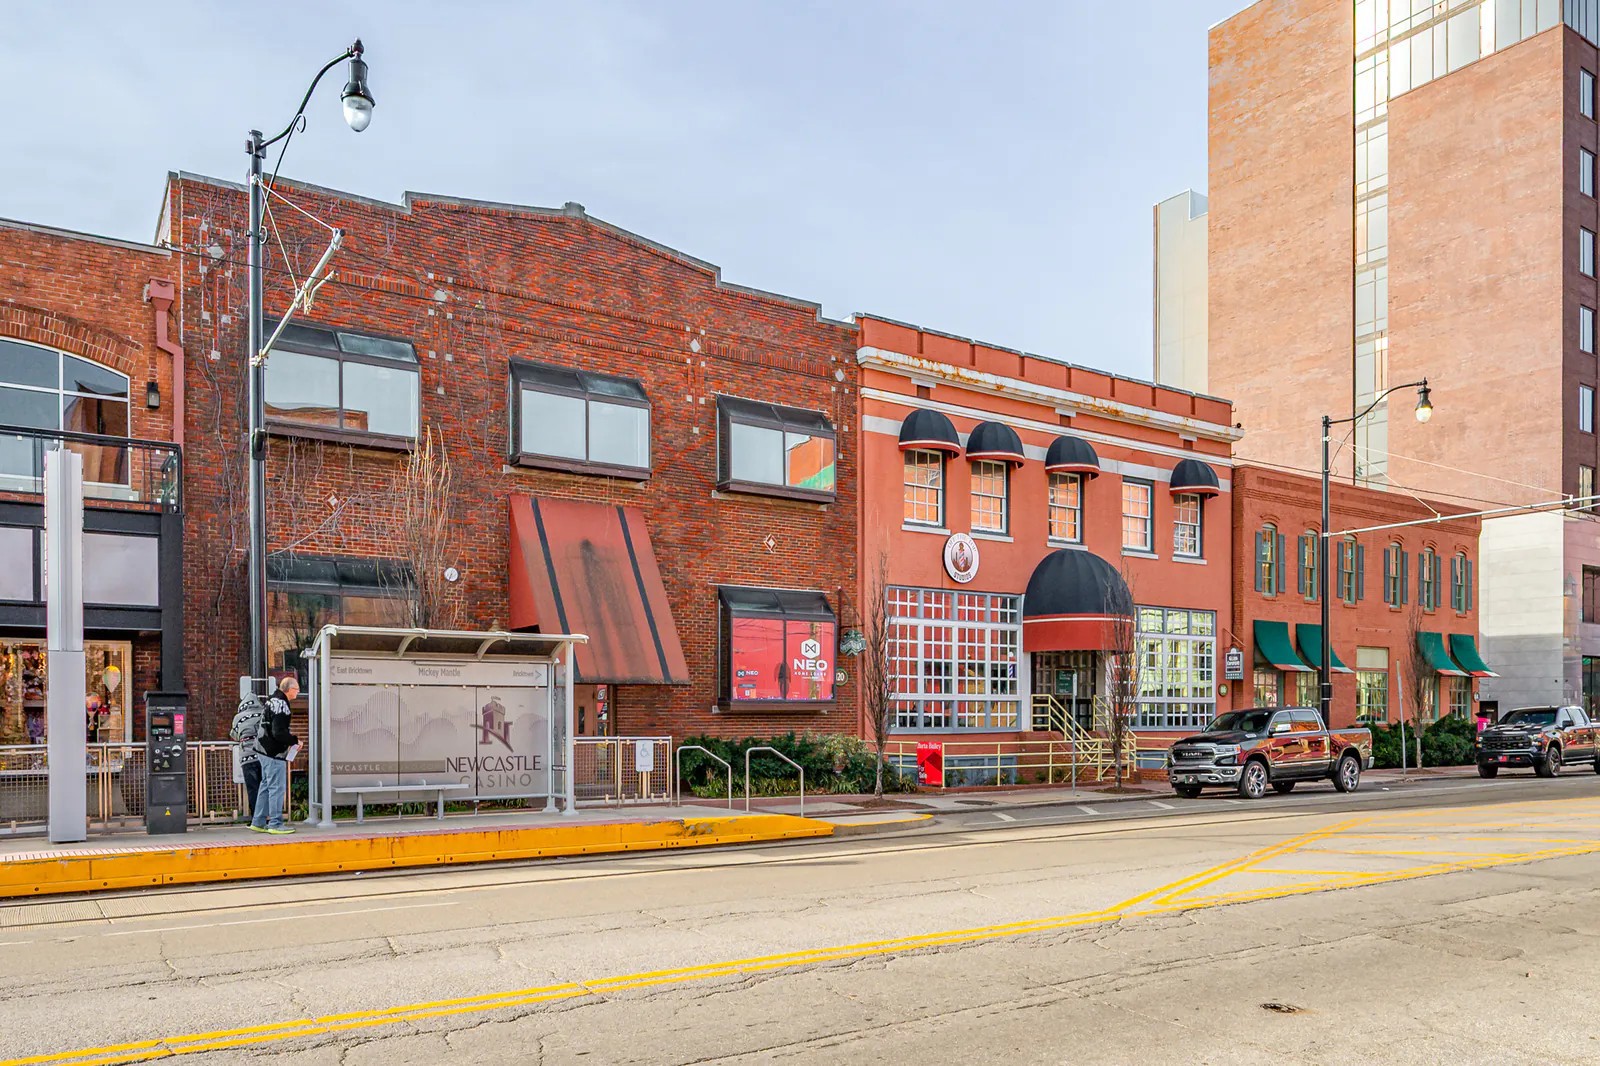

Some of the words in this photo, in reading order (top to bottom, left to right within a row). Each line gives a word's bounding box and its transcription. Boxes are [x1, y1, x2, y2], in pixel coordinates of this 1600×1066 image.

[348, 667, 373, 675] Bricktown
[793, 658, 828, 671] NEO
[418, 668, 439, 679] Mickey
[440, 668, 461, 677] Mantle
[446, 755, 542, 773] NEWCASTLE
[459, 773, 532, 789] CASINO
